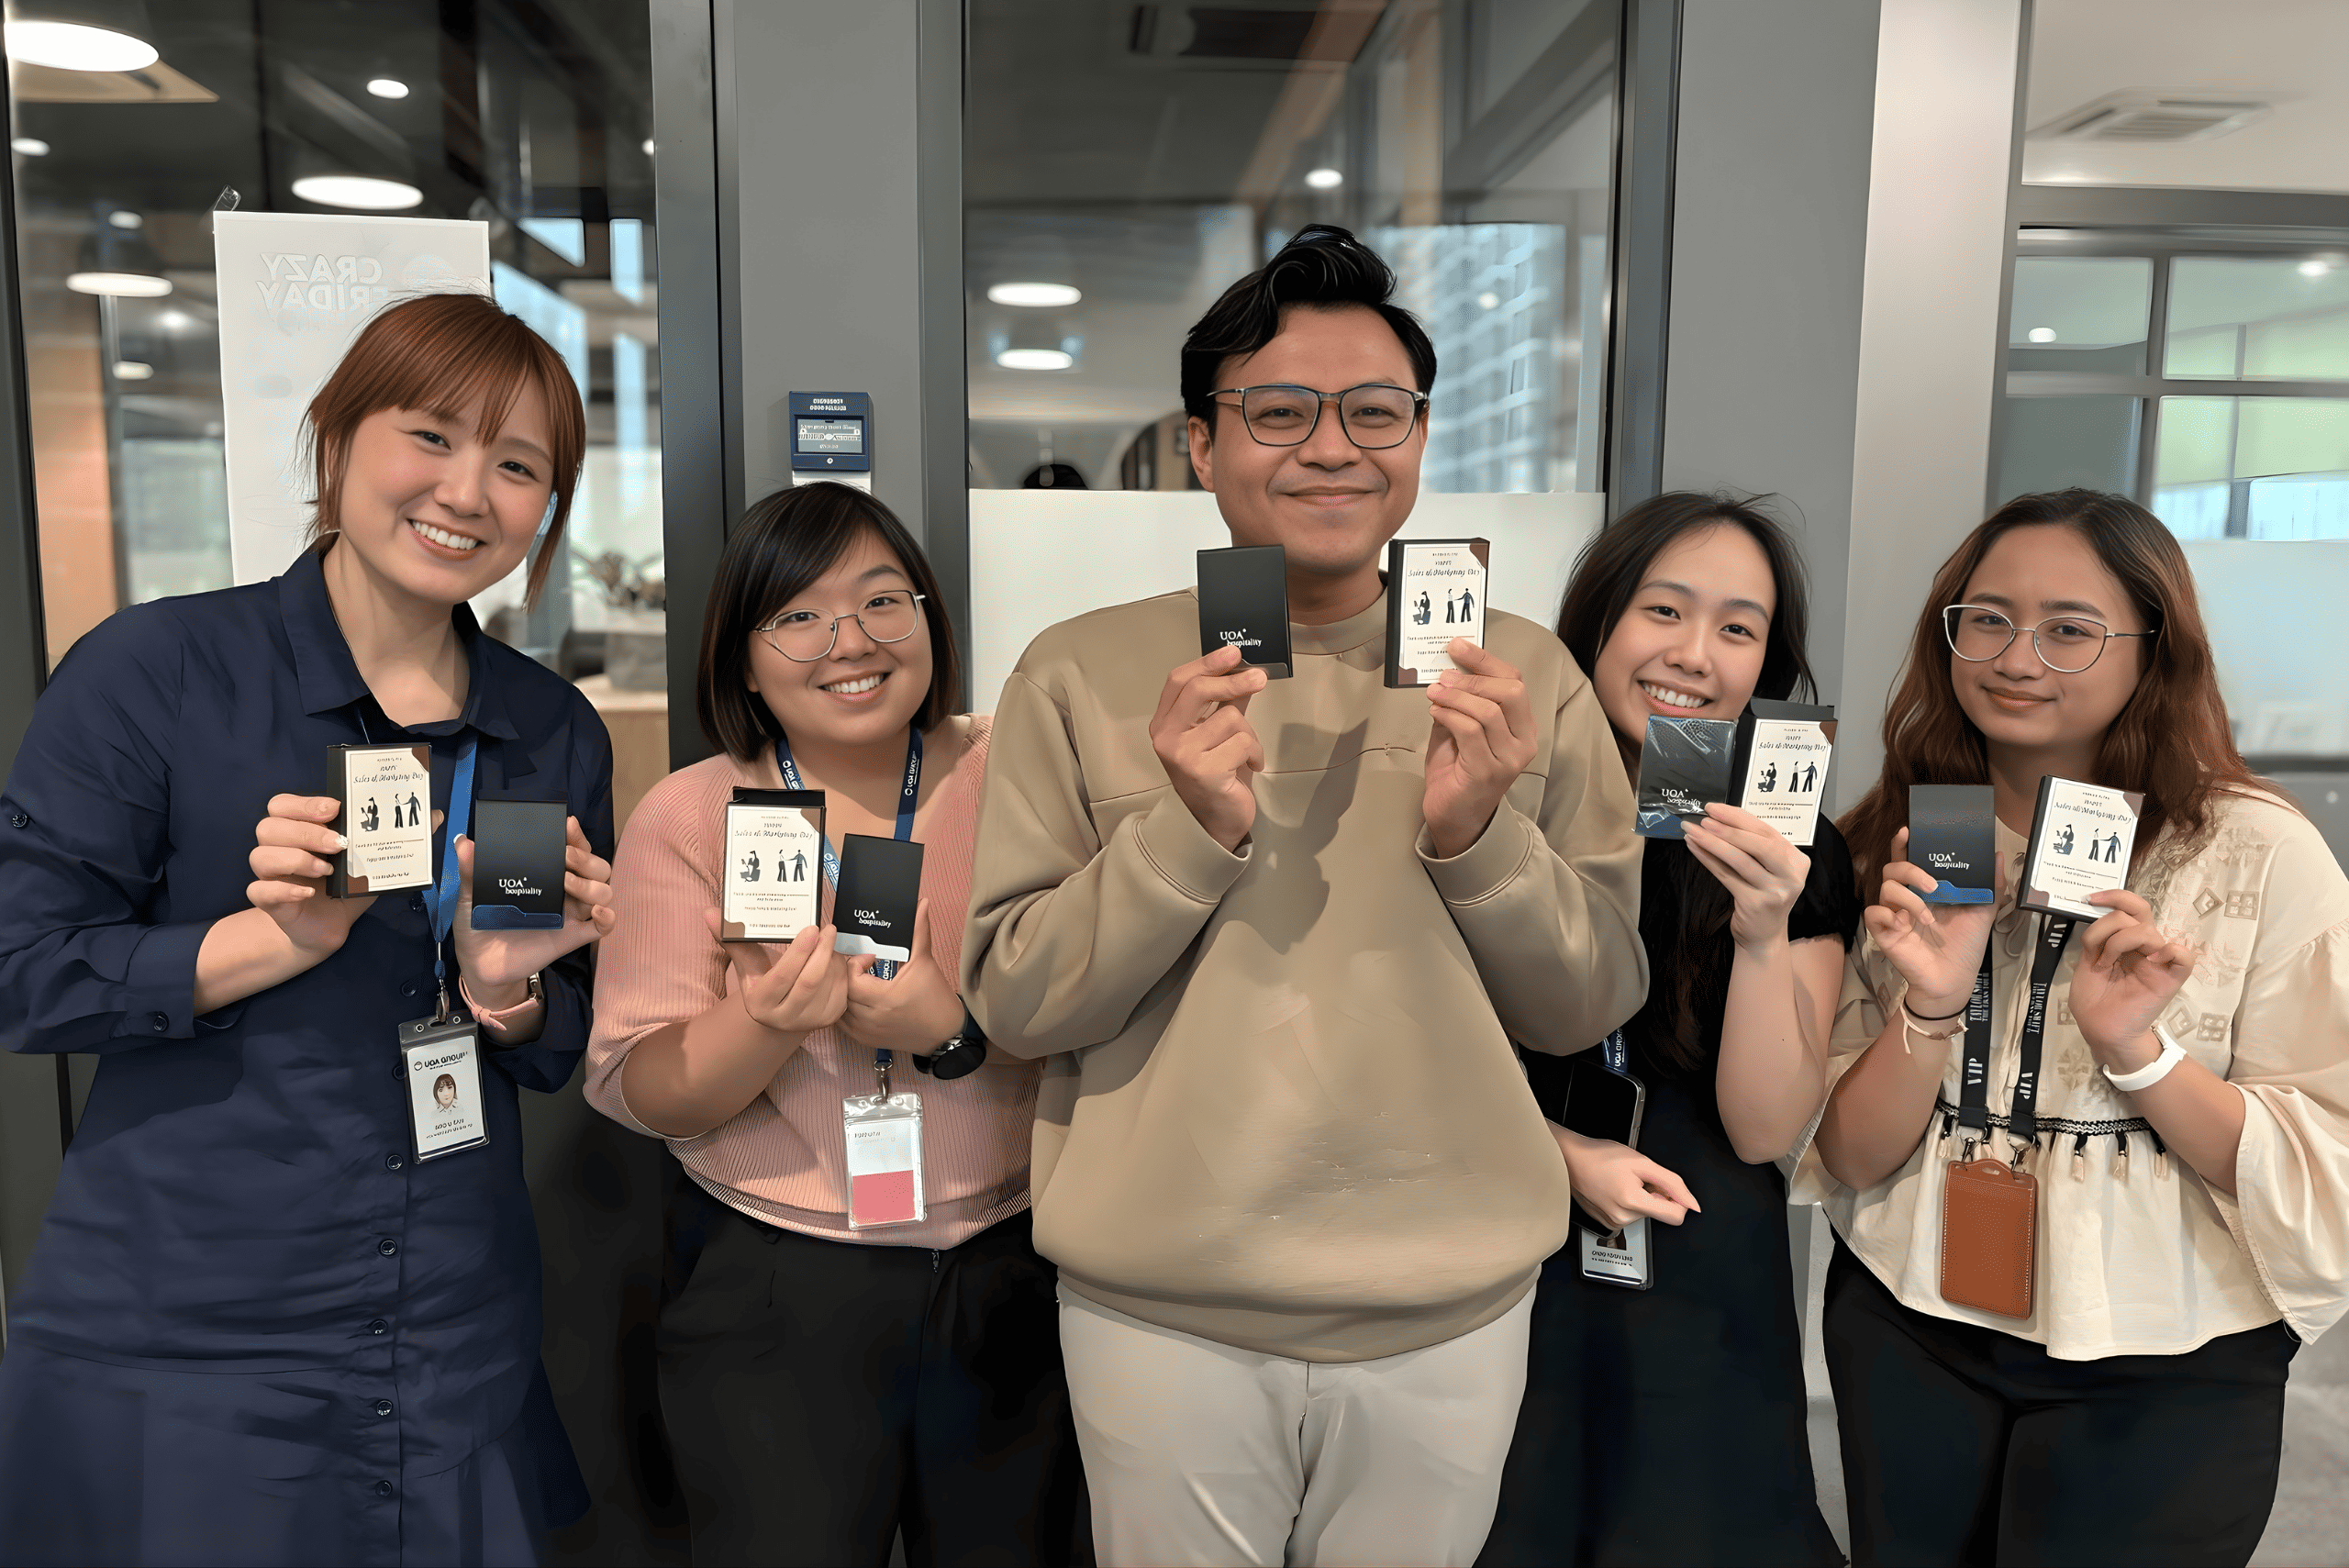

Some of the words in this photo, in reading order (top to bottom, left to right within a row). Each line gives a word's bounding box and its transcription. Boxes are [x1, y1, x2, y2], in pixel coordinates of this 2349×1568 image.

[1219, 631, 1244, 640] UOA
[1662, 789, 1685, 798] UOA
[1929, 853, 1952, 862] UOA
[498, 879, 524, 888] UOA
[854, 909, 875, 919] UOA
[2048, 924, 2067, 948] VIP
[1967, 1058, 1983, 1084] VIP
[2020, 1072, 2033, 1099] VIP
